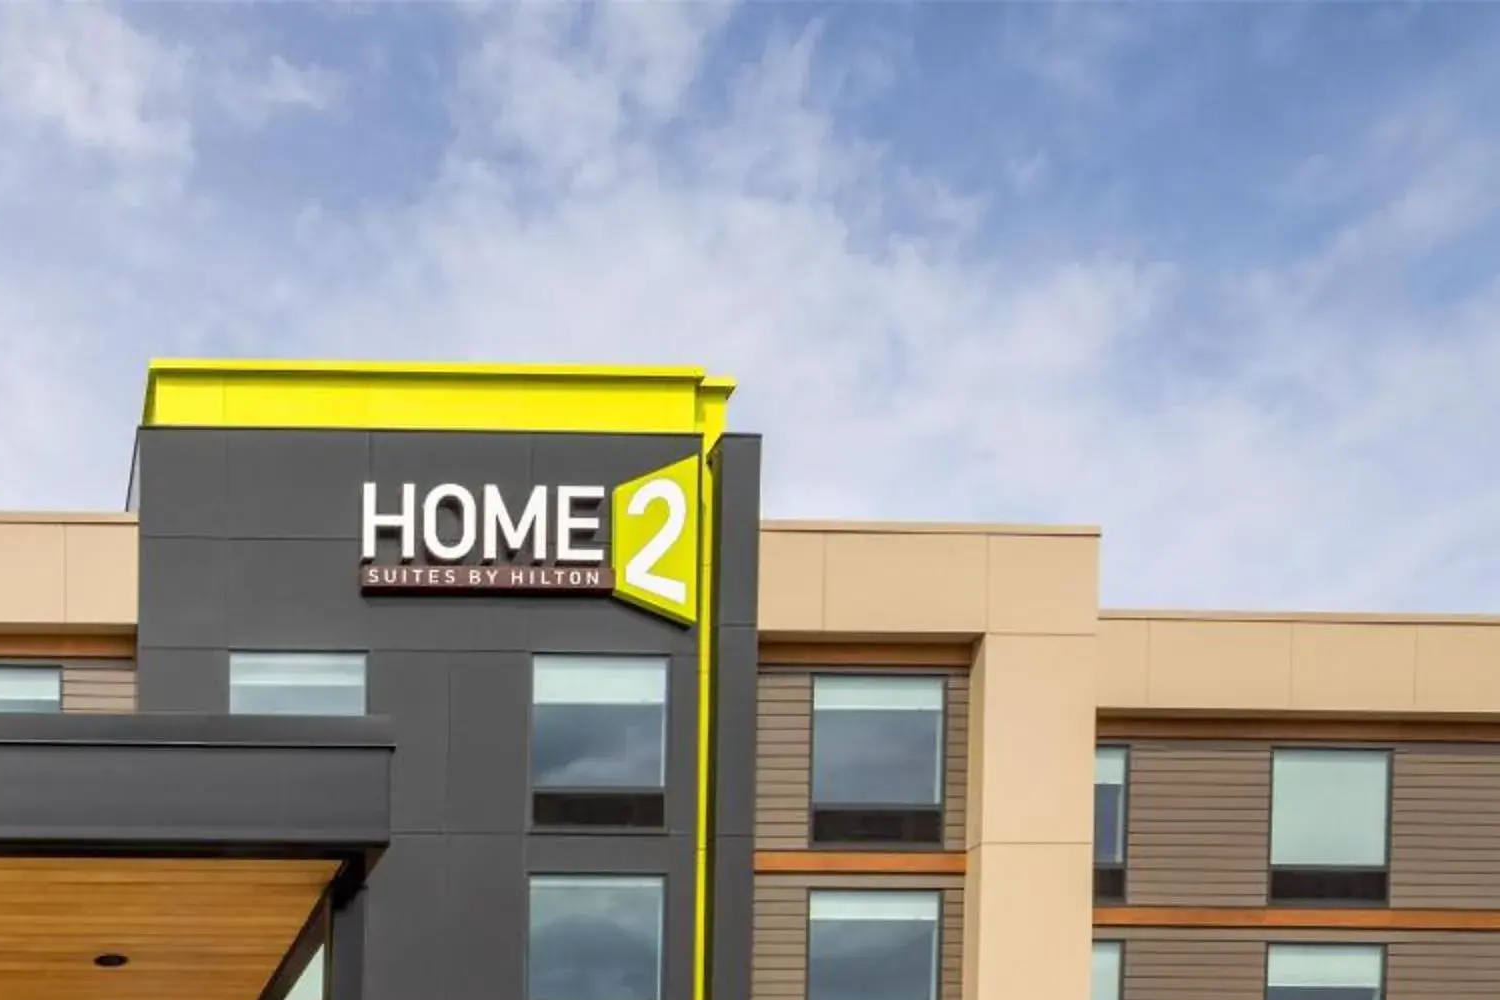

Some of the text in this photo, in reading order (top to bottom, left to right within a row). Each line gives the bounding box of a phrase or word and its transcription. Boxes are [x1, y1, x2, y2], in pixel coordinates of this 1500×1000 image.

[362, 478, 687, 605] HOME 2
[367, 568, 600, 586] SUITES BY HILTON
